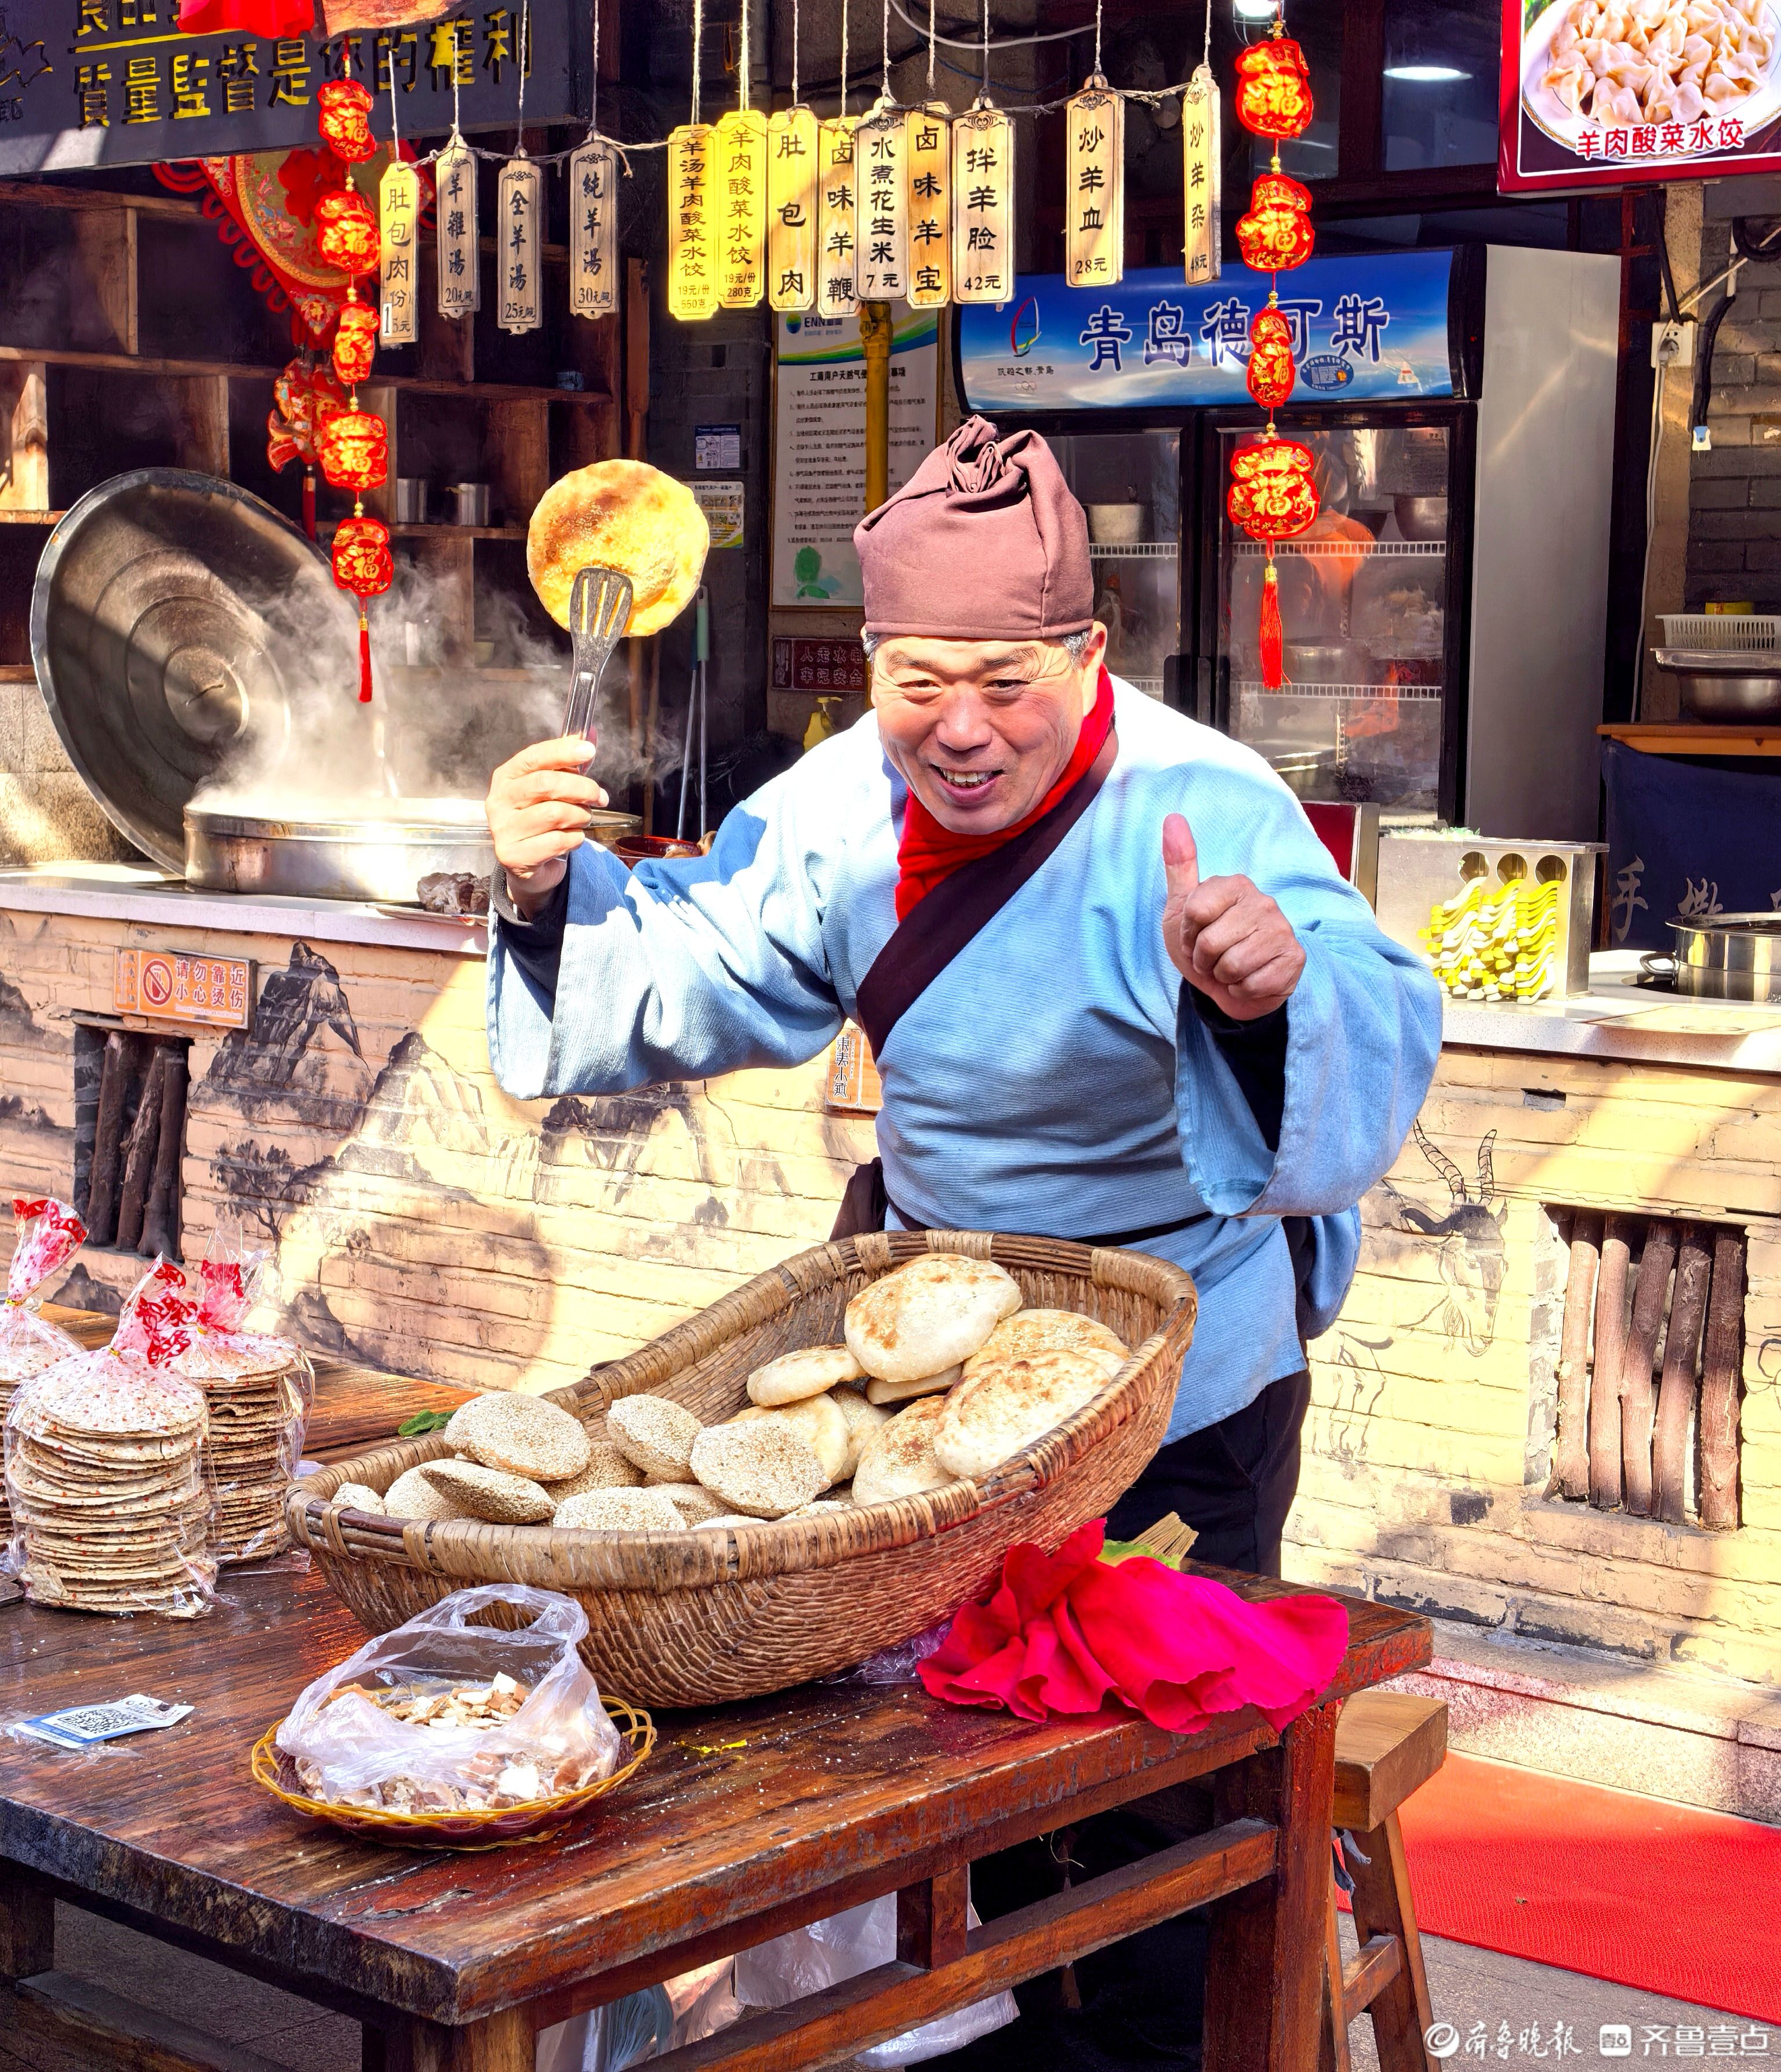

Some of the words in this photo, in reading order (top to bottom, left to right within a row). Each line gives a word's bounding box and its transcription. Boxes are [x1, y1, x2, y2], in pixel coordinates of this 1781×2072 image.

[1078, 125, 1105, 232] 炒羊血
[1190, 120, 1205, 230] 炒羊杂
[1576, 118, 1744, 158] 羊肉酸菜水饺
[386, 189, 411, 282] 肚包肉
[679, 141, 707, 277] 羊汤羊肉酸菜水饺
[726, 129, 754, 265] 羊肉酸菜水饺
[777, 134, 806, 296] 肚包肉
[827, 140, 855, 303] 卤味羊鞭
[870, 137, 896, 264] 水煮花生米
[913, 125, 943, 292] 卤味羊宝
[966, 147, 998, 252] 拌羊脸
[678, 286, 710, 296] 19元/份
[681, 299, 706, 310] 550克
[724, 273, 756, 284] 19元/份
[727, 286, 752, 298] 280克
[964, 274, 1001, 291] 42元
[1075, 257, 1107, 274] 28元
[176, 959, 245, 986] 请勿靠近
[176, 982, 243, 1009] 小心烫伤
